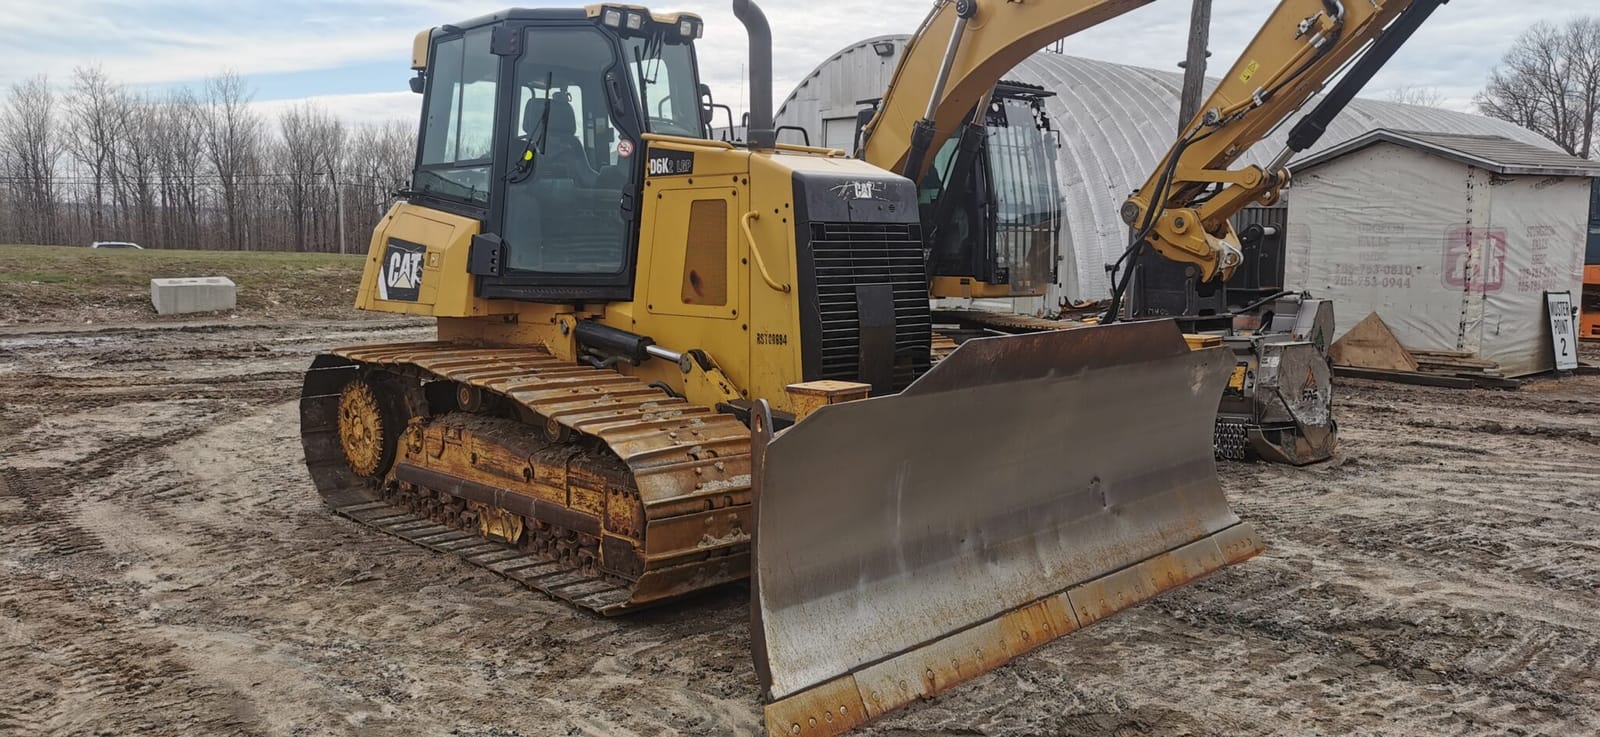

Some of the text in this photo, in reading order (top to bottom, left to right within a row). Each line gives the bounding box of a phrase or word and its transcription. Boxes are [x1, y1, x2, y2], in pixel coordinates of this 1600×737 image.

[855, 182, 873, 199] CAT
[387, 252, 422, 289] CAT
[1550, 301, 1569, 316] MUSTER
[1554, 319, 1568, 335] POINT
[1560, 337, 1568, 356] 2
